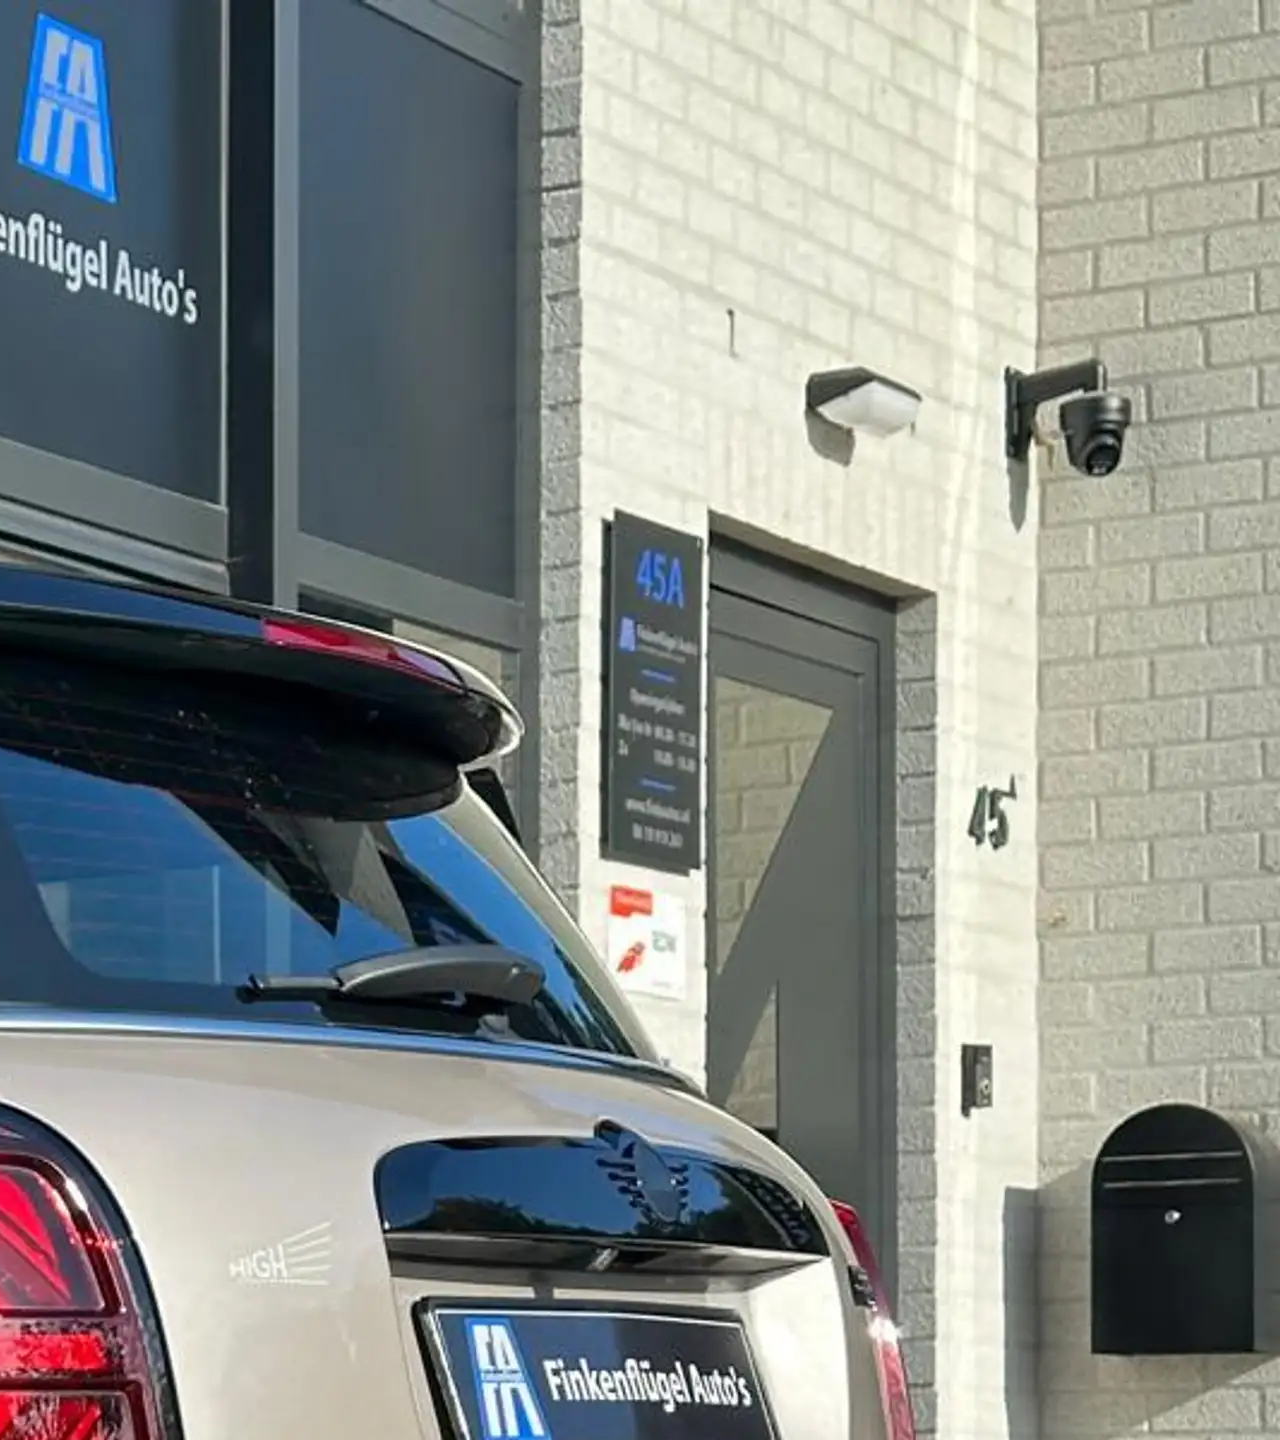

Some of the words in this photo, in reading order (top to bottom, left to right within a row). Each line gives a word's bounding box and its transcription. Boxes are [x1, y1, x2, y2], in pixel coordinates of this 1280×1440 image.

[113, 250, 198, 325] Auto's
[635, 548, 685, 608] 45A
[967, 774, 1017, 851] 45
[542, 1356, 691, 1413] Finkenflügel
[689, 1362, 753, 1407] Auto's
